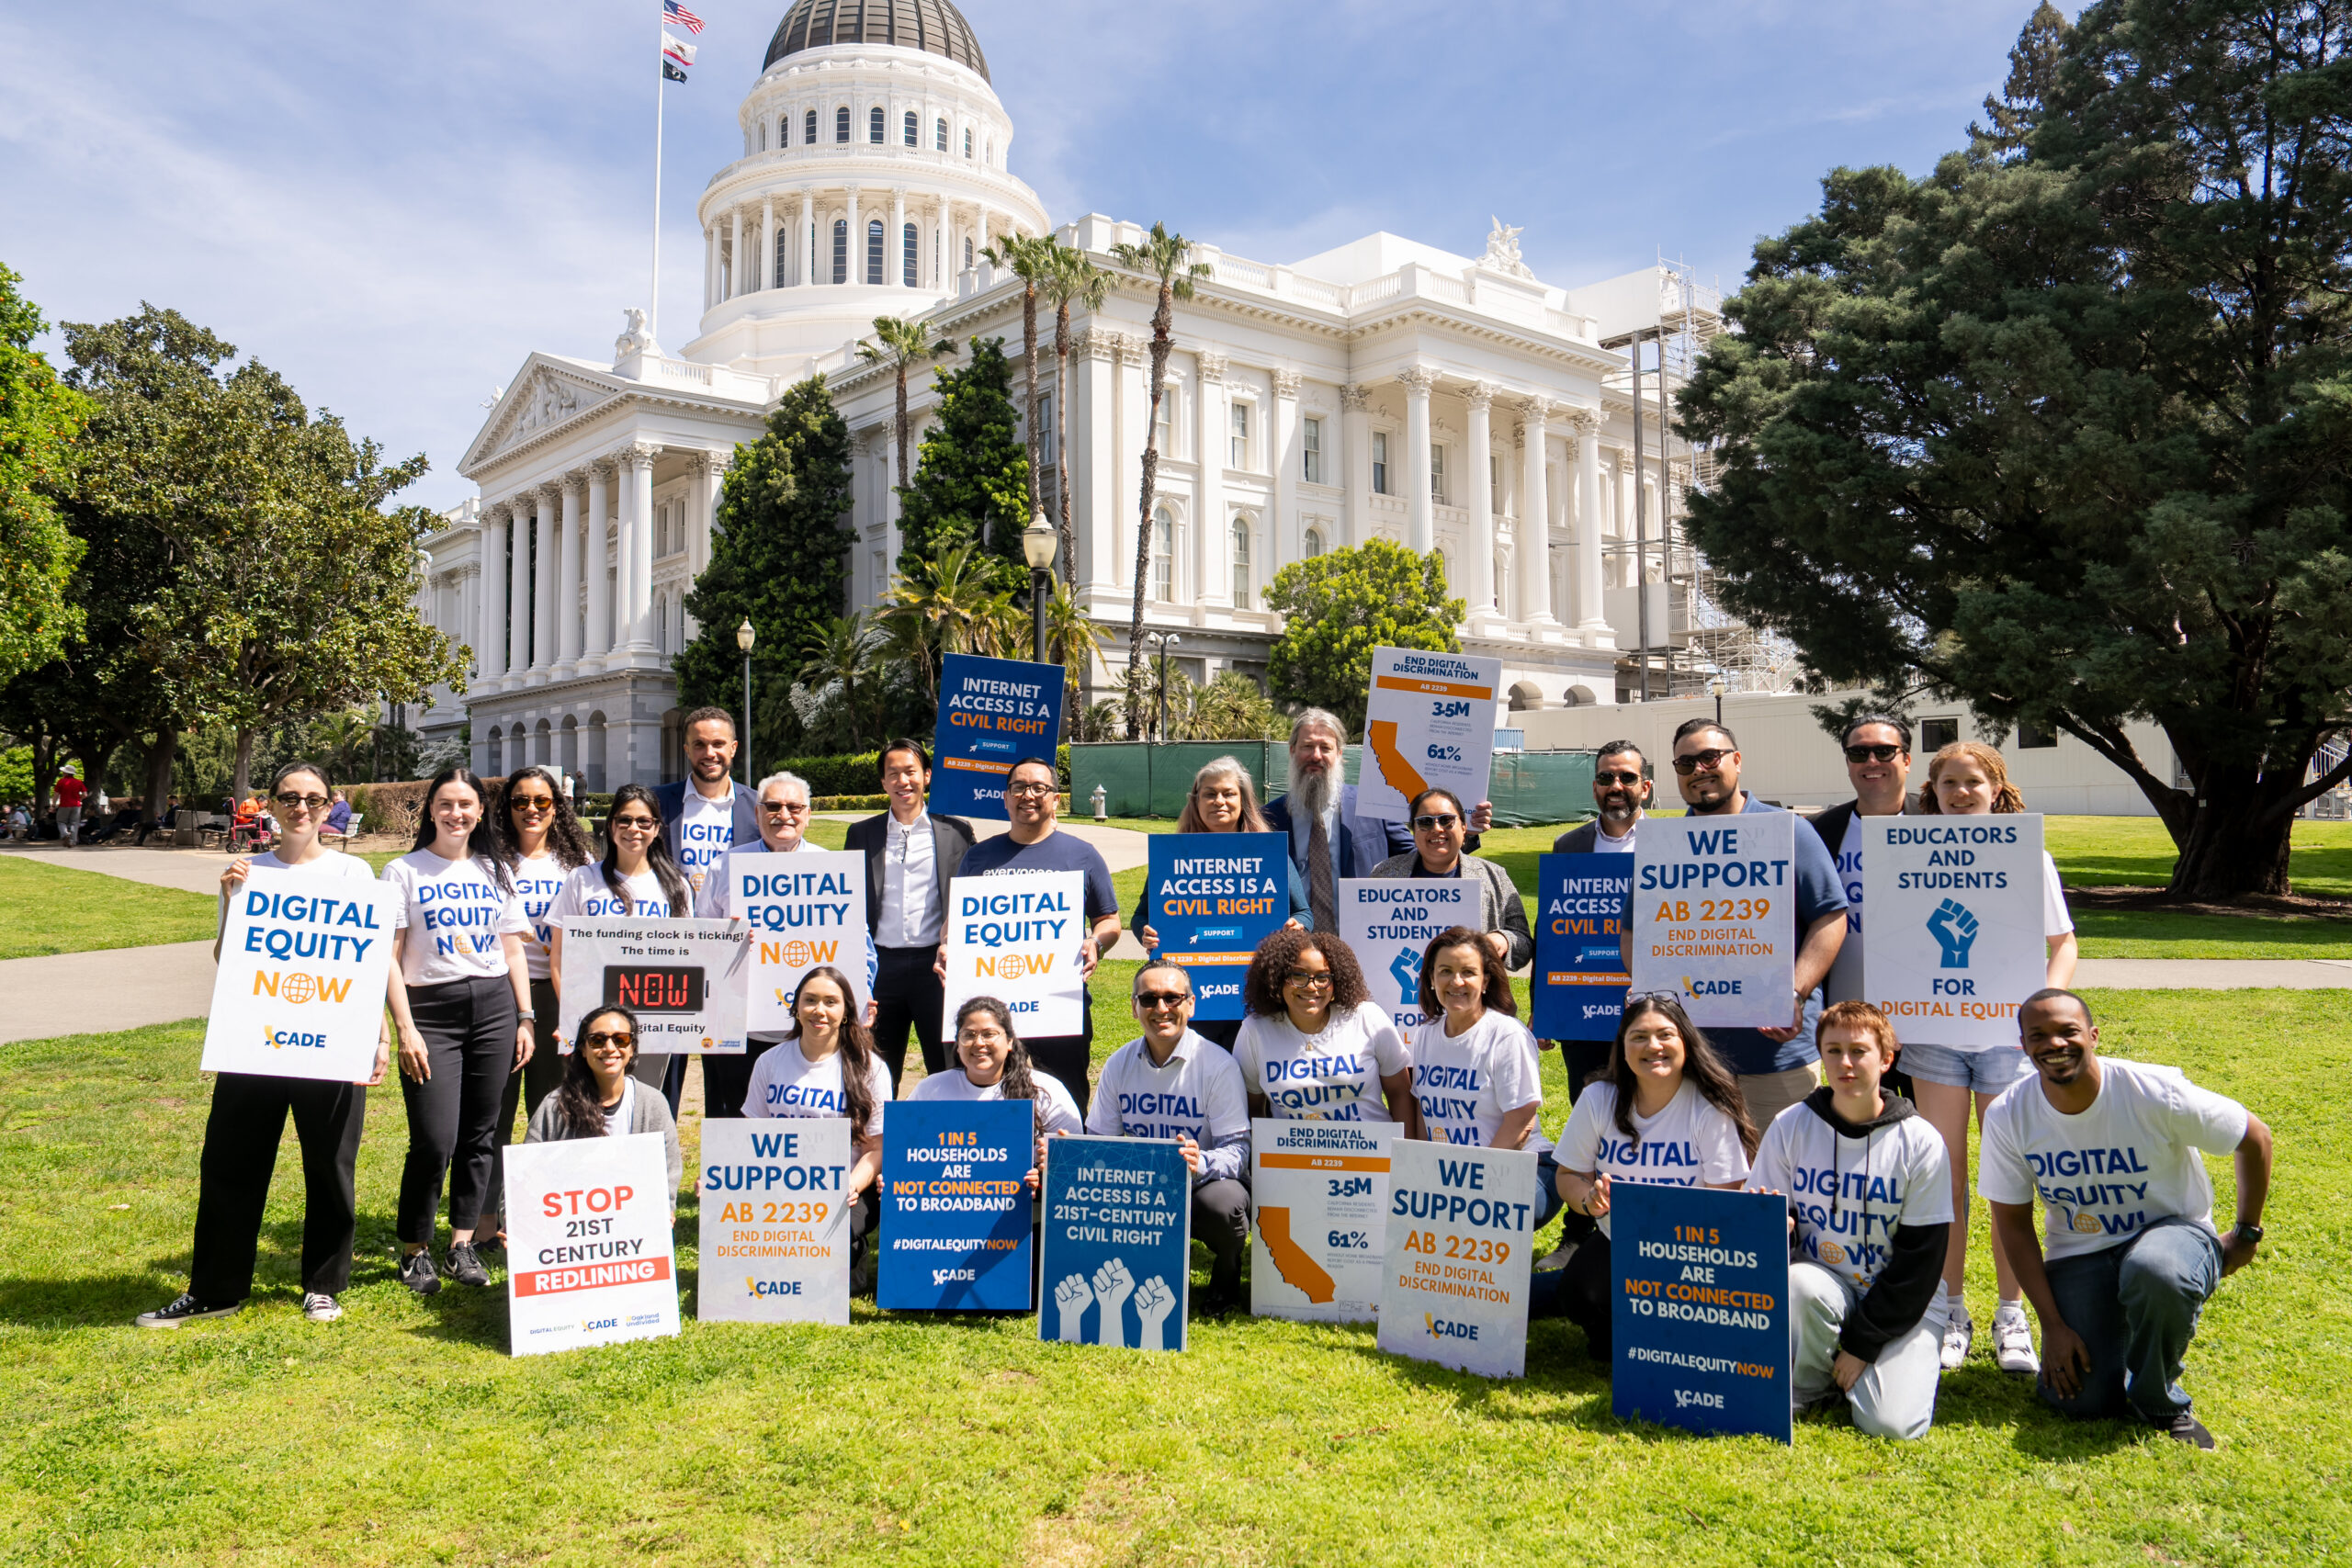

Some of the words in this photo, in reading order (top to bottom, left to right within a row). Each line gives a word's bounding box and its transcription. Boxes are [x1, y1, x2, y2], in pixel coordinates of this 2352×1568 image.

[1393, 664, 1478, 680] DISCRIMINATION
[1405, 656, 1426, 666] END
[1428, 659, 1468, 670] DIGITAL
[963, 678, 1041, 698] INTERNET
[948, 694, 1014, 713] ACCESS
[1019, 702, 1034, 716] IS
[1037, 705, 1050, 717] A
[1432, 702, 1470, 717] 3.5M
[950, 712, 991, 729] CIVIL
[997, 718, 1046, 735] RIGHT
[1428, 744, 1461, 761] 61%
[1688, 829, 1737, 855] WE
[1887, 827, 2017, 844] EDUCATORS
[1174, 858, 1262, 874] INTERNET
[1928, 850, 1975, 866] AND
[743, 873, 853, 897] DIGITAL
[1639, 860, 1788, 890] SUPPORT
[1898, 872, 2007, 889] STUDENTS
[419, 882, 503, 904] DIGITAL
[1160, 879, 1235, 896] ACCESS
[1241, 878, 1258, 894] IS
[1262, 878, 1277, 893] A
[1359, 889, 1461, 902] EDUCATORS
[1563, 878, 1632, 894] INTERN
[246, 891, 379, 930] DIGITAL
[962, 892, 1070, 917] DIGITAL
[1164, 899, 1212, 916] CIVIL
[1217, 898, 1274, 915] RIGHT
[1391, 908, 1429, 920] AND
[1549, 898, 1621, 915] ACCESS
[1655, 901, 1690, 922] AB
[1700, 898, 1770, 921] 2239
[425, 907, 501, 931] EQUITY
[748, 903, 850, 931] EQUITY
[1552, 919, 1598, 934] CIVIL
[570, 930, 593, 938] The
[597, 930, 642, 940] funding
[647, 931, 679, 939] clock
[684, 931, 694, 939] is
[698, 931, 743, 942] ticking!
[965, 919, 1067, 947] EQUITY
[1668, 930, 1696, 941] END
[1701, 928, 1756, 941] DIGITAL
[245, 926, 374, 963] EQUITY
[621, 946, 643, 954] The
[648, 946, 674, 955] time
[679, 947, 689, 955] is
[761, 941, 838, 967] NOW
[1653, 943, 1773, 956] DISCRIMINATION
[976, 953, 1055, 979] NOW
[253, 970, 353, 1004] NOW
[619, 974, 688, 1006] NOW
[1206, 985, 1239, 995] CADE
[1692, 980, 1741, 995] CADE
[1933, 978, 1976, 995] FOR
[1009, 1001, 1039, 1012] ADE
[1589, 1005, 1621, 1015] CADE
[1882, 1000, 1954, 1017] DIGITAL
[1961, 1002, 2021, 1021] EQUIT
[637, 1024, 662, 1034] gital
[668, 1024, 706, 1034] Equity
[274, 1031, 326, 1048] CADE
[1266, 1055, 1364, 1082] DIGITAL
[1417, 1065, 1480, 1090] DIGITAL
[766, 1084, 847, 1113] DIGITAL
[1119, 1093, 1204, 1118] DIGITAL
[1271, 1082, 1365, 1109] EQUITY
[1420, 1096, 1477, 1120] QUITY
[938, 1133, 944, 1145] 1
[949, 1133, 964, 1145] IN
[967, 1133, 977, 1145] 5
[1277, 1137, 1377, 1150] DISCRIMINATION
[1290, 1128, 1314, 1137] END
[1317, 1129, 1364, 1139] DIGITAL
[752, 1134, 798, 1158] WE
[907, 1148, 1007, 1162] HOUSEHOLDS
[1598, 1137, 1698, 1167] DIGITAL
[942, 1165, 971, 1179] ARE
[1325, 1159, 1343, 1168] 2239
[2025, 1147, 2148, 1178] DIGITAL
[706, 1166, 845, 1190] SUPPORT
[1078, 1168, 1156, 1185] INTERNET
[1438, 1159, 1485, 1190] WE
[893, 1181, 925, 1195] NOT
[929, 1181, 1020, 1195] CONNECTED
[1329, 1178, 1372, 1197] 3.5M
[1793, 1167, 1903, 1204] DIGITAL
[2040, 1181, 2148, 1207] EQUITY
[543, 1185, 634, 1217] STOP
[897, 1198, 918, 1211] TO
[921, 1198, 1015, 1212] BROADBAND
[1066, 1187, 1131, 1204] ACCESS
[1136, 1191, 1149, 1205] IS
[1154, 1192, 1166, 1206] A
[720, 1202, 753, 1223] AB
[763, 1202, 829, 1223] 2239
[1054, 1205, 1177, 1226] 21ST-CENTURY
[1392, 1189, 1530, 1231] SUPPORT
[1796, 1201, 1898, 1235] EQUITY
[566, 1217, 614, 1238] 21ST
[733, 1231, 760, 1242] END
[763, 1231, 815, 1242] DIGITAL
[1067, 1226, 1108, 1243] CIVIL
[1112, 1229, 1162, 1246] RIGHT
[1674, 1225, 1681, 1241] 1
[1686, 1226, 1703, 1243] IN
[1709, 1228, 1720, 1245] 5
[893, 1239, 1018, 1252] #DIGITALEQUITYNOW
[1328, 1230, 1368, 1249] 61%
[1404, 1230, 1436, 1254] AB
[1444, 1235, 1510, 1264] 2239
[538, 1238, 643, 1265] CENTURY
[718, 1246, 831, 1258] DISCRIMINATION
[1639, 1241, 1758, 1269] HOUSEHOLDS
[535, 1261, 655, 1292] REDLINING
[941, 1269, 975, 1280] CADE
[1415, 1261, 1441, 1276] END
[1444, 1265, 1495, 1285] DIGITAL
[1680, 1265, 1714, 1284] ARE
[756, 1281, 801, 1294] CADE
[1399, 1275, 1510, 1304] DISCRIMINATION
[1625, 1279, 1662, 1298] NOT
[1666, 1283, 1774, 1311] CONNECTED
[588, 1318, 617, 1330] CADE
[627, 1318, 660, 1326] Undivided
[1630, 1298, 1654, 1315] TO
[1657, 1301, 1770, 1330] BROADBAND
[1433, 1319, 1478, 1340] CADE
[1628, 1347, 1774, 1379] #DIGITALEQUITYNOW
[1684, 1390, 1724, 1409] CADE
